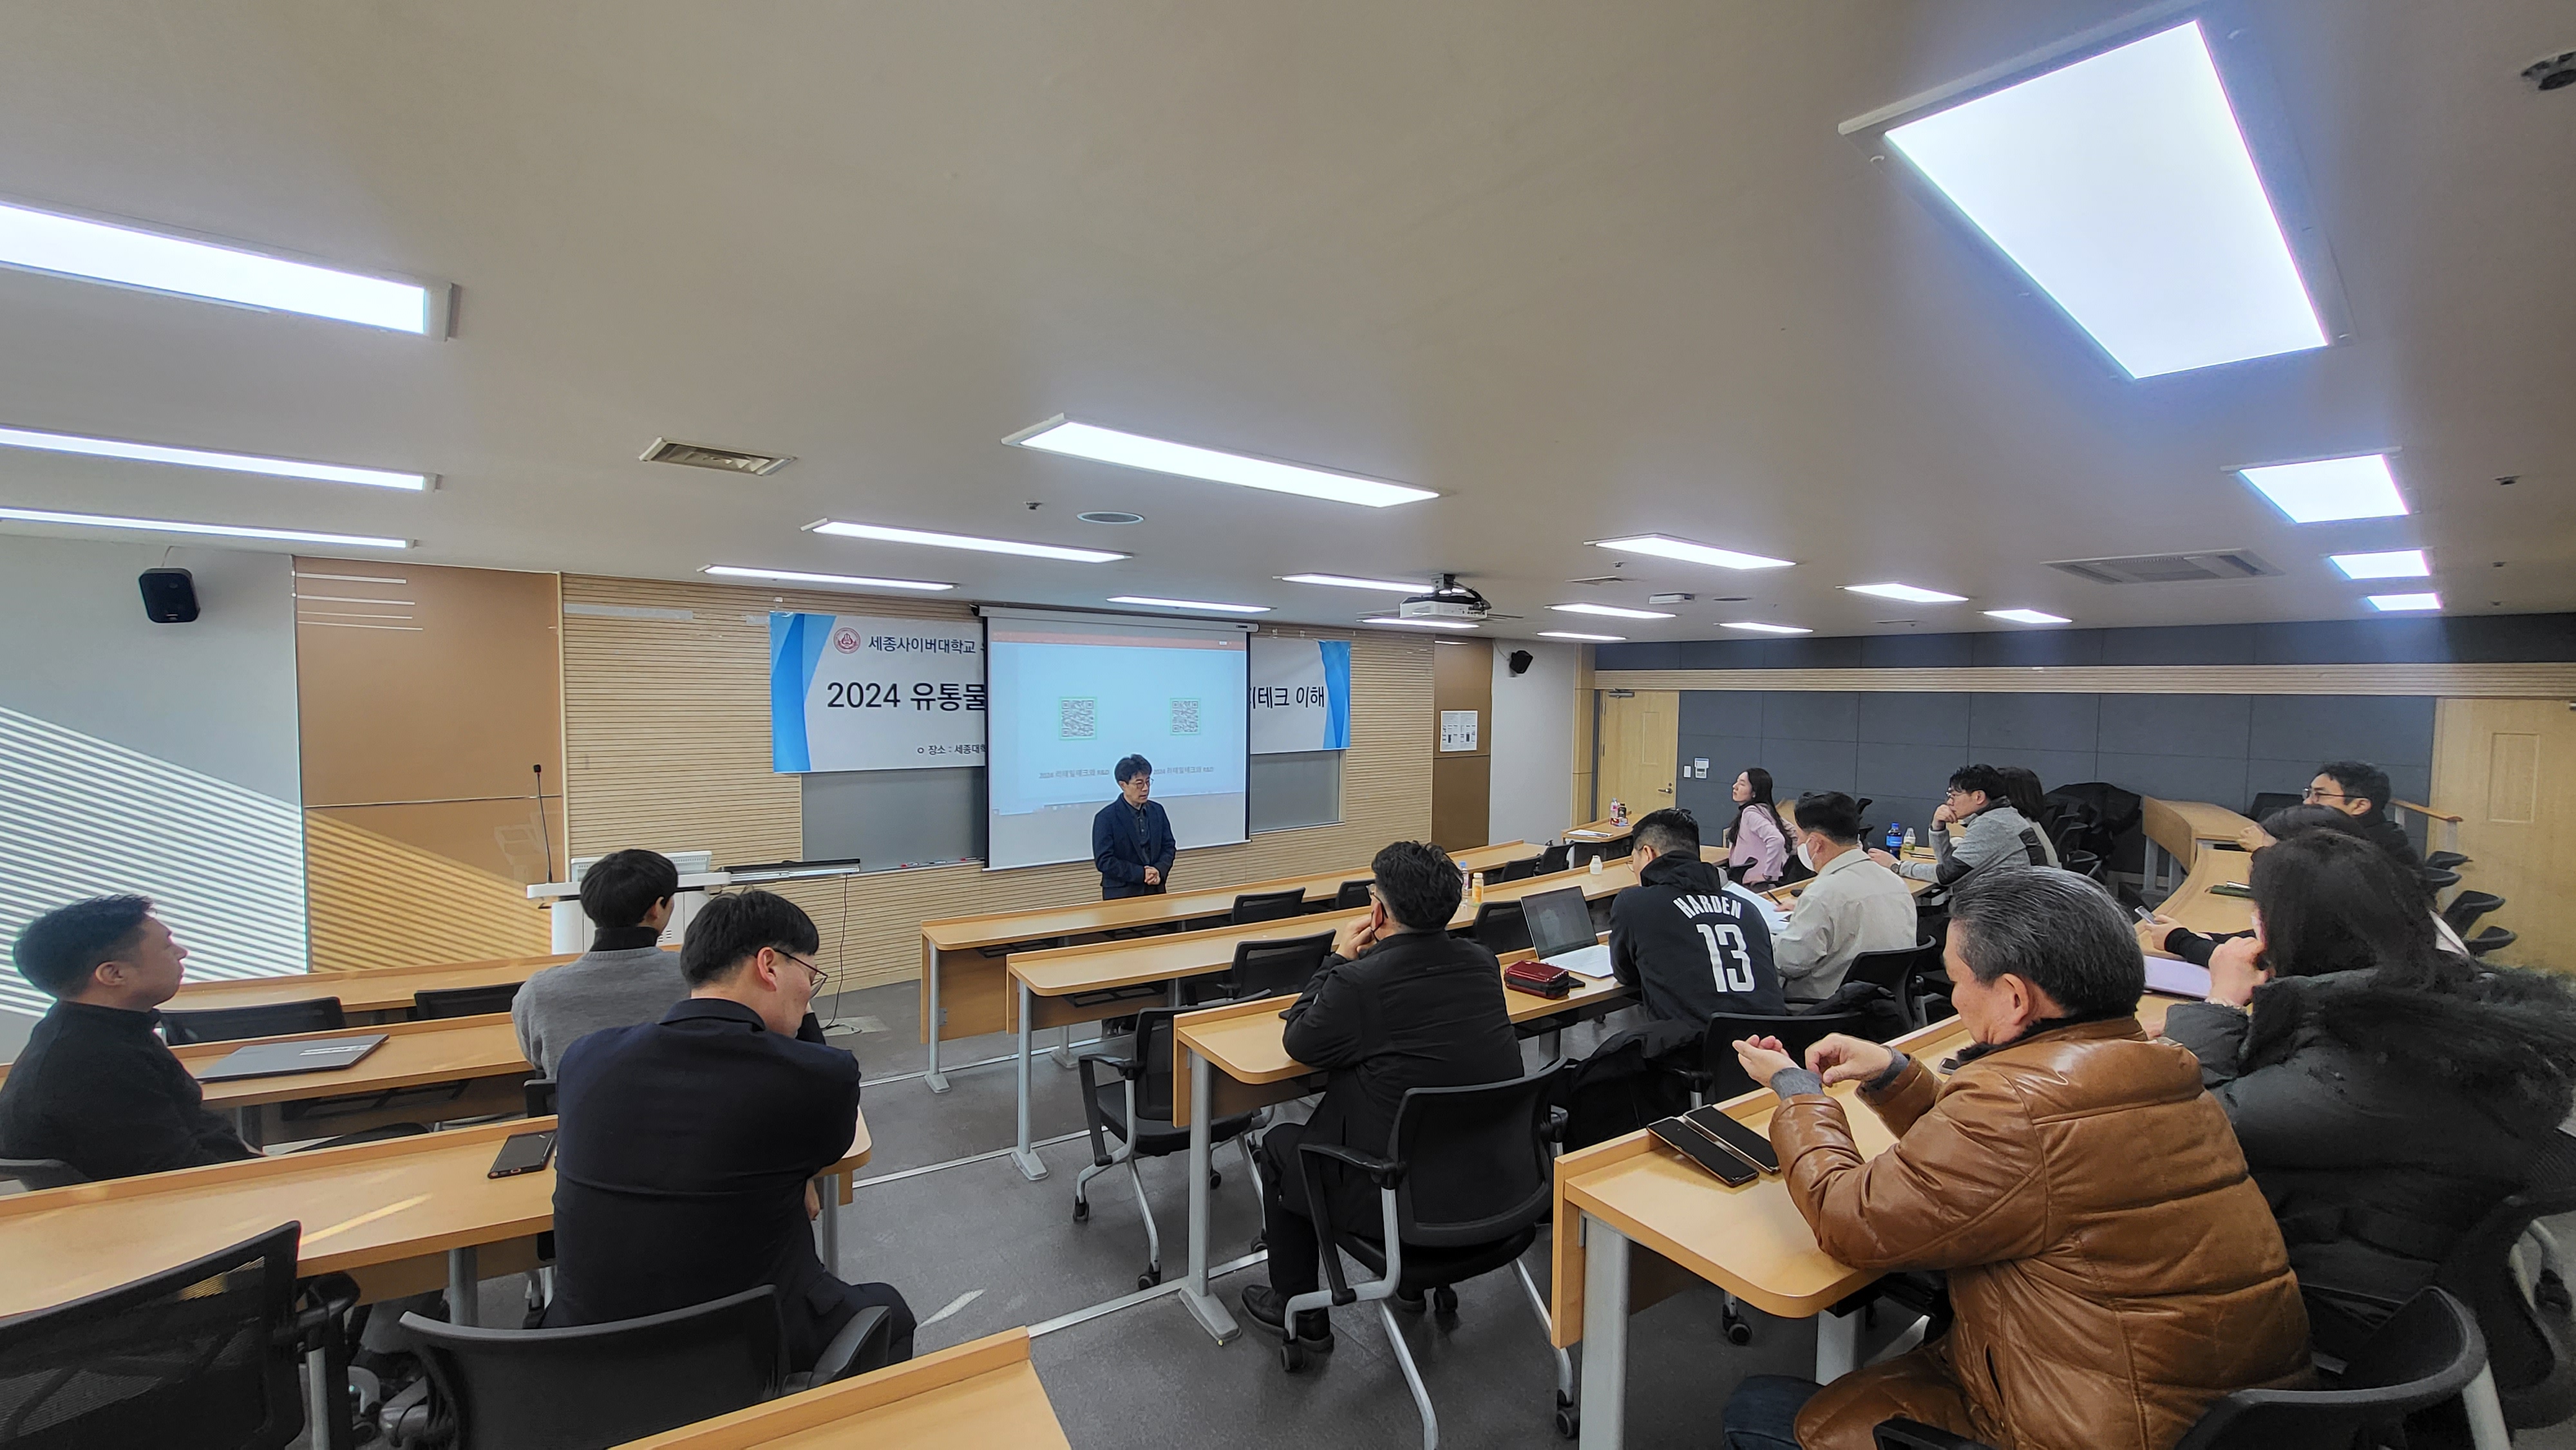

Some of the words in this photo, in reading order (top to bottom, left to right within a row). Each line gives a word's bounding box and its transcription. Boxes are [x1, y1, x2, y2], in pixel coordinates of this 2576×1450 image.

[869, 636, 976, 654] 세종사이버대학교
[827, 682, 900, 708] 2024
[1296, 686, 1325, 708] 이해
[928, 745, 946, 755] 장소
[1673, 894, 1741, 919] HARDEN
[1696, 923, 1755, 992] 13
